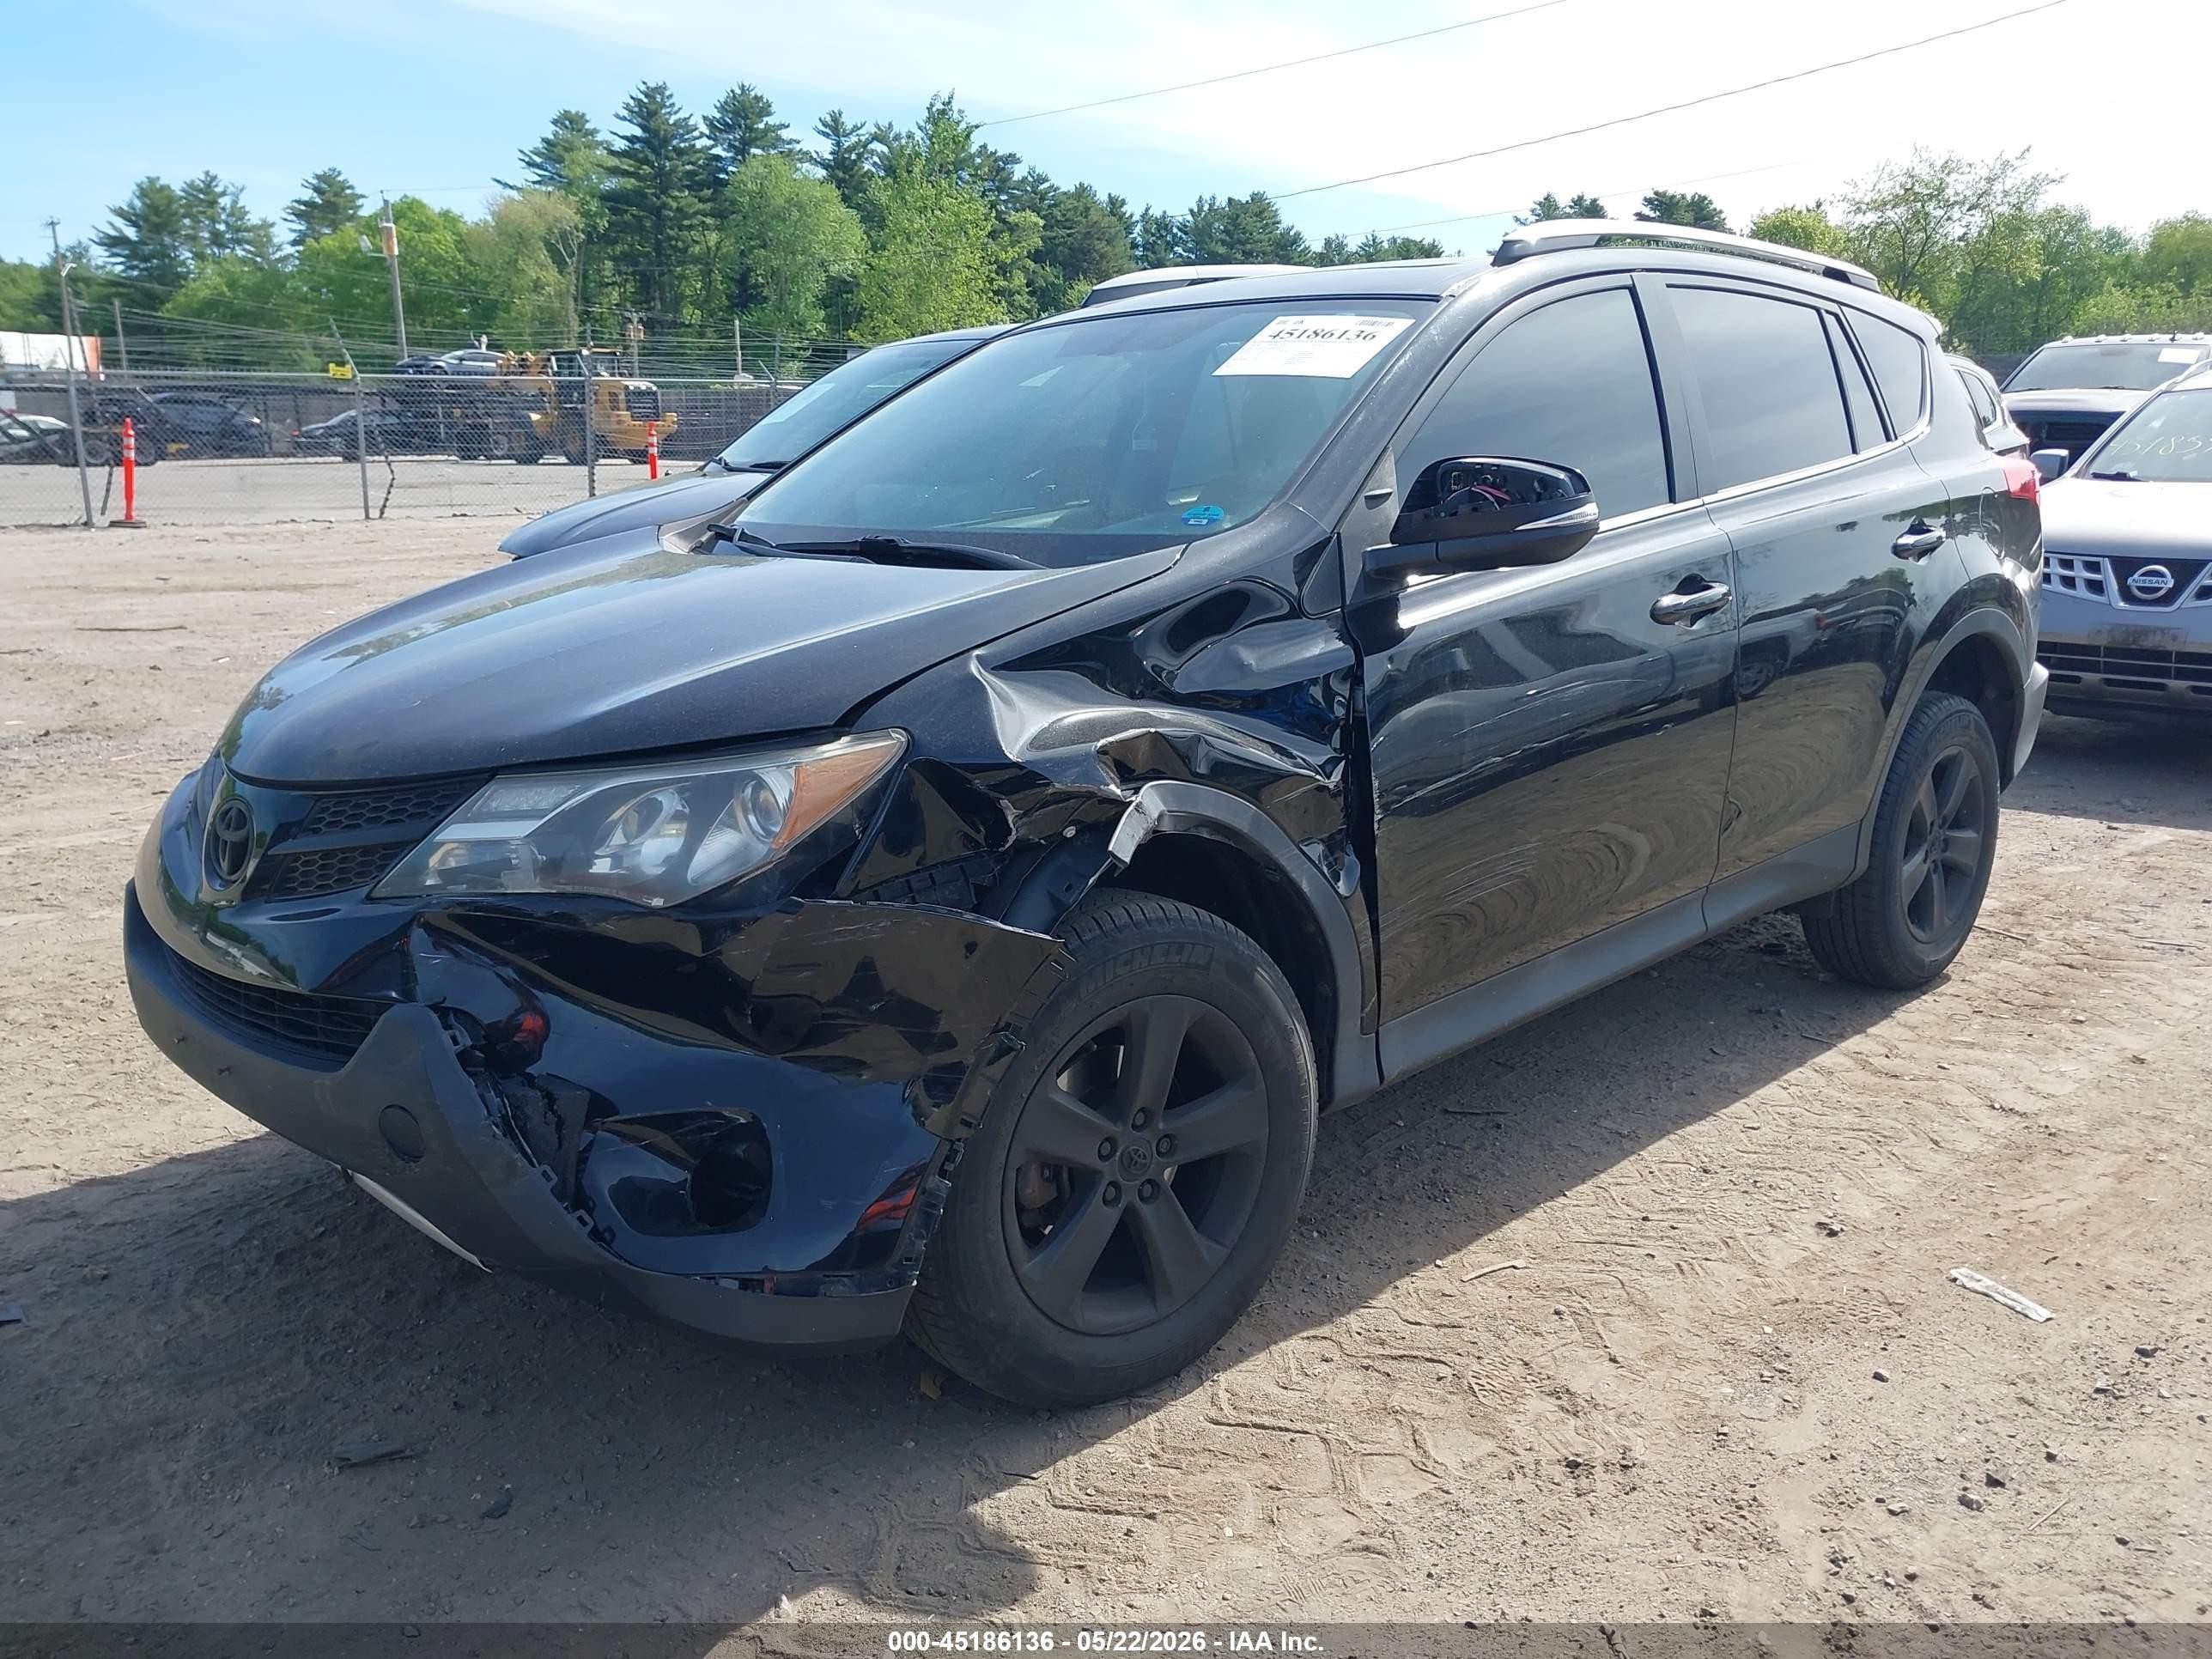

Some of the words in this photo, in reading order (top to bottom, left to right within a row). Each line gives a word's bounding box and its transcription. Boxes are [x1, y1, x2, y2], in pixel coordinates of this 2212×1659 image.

[1267, 326, 1381, 342] 45186136
[2130, 577, 2169, 586] NISSAN
[1079, 943, 1216, 999] MICHELIN
